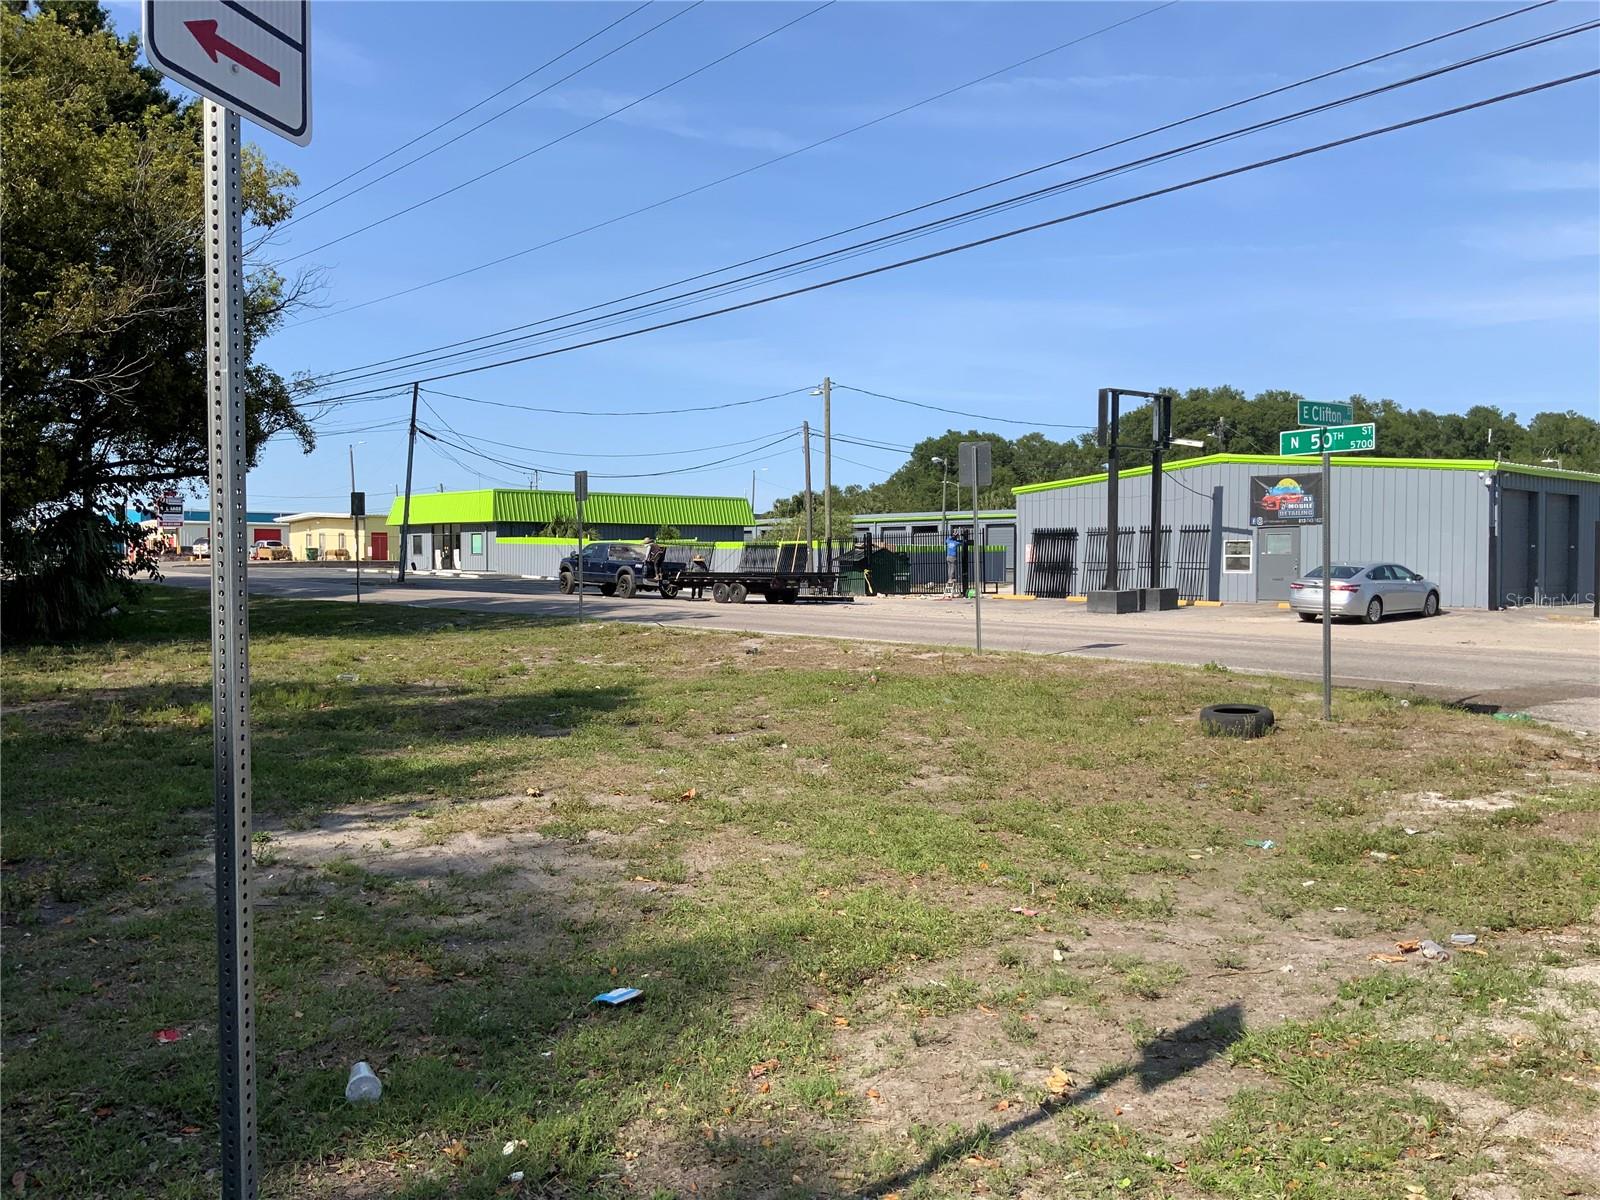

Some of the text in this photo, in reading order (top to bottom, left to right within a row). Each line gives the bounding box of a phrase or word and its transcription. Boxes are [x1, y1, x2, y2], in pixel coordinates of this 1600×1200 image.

[1303, 406, 1309, 419] E
[1312, 405, 1342, 424] Clifton
[1361, 425, 1373, 436] ST
[1290, 436, 1299, 449] N
[1350, 439, 1374, 449] 5700
